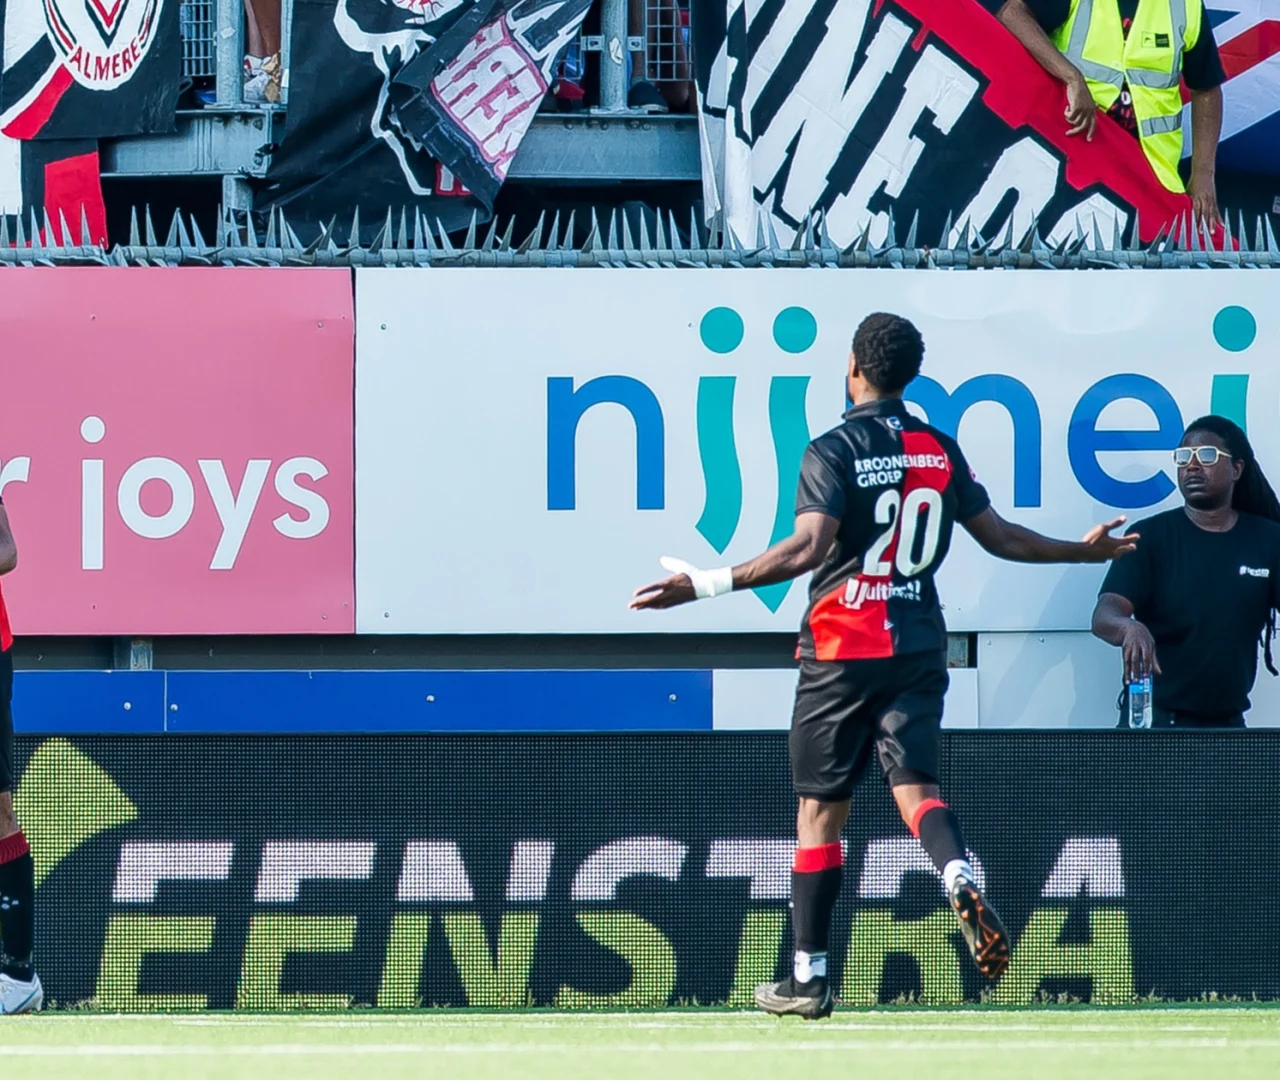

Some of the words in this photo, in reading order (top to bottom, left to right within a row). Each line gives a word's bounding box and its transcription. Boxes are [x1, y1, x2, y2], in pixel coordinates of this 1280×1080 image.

[69, 42, 140, 82] ALMERE
[854, 453, 946, 474] KROONENBERG
[856, 469, 903, 488] GROEP
[80, 415, 332, 571] joys
[862, 487, 943, 577] 20
